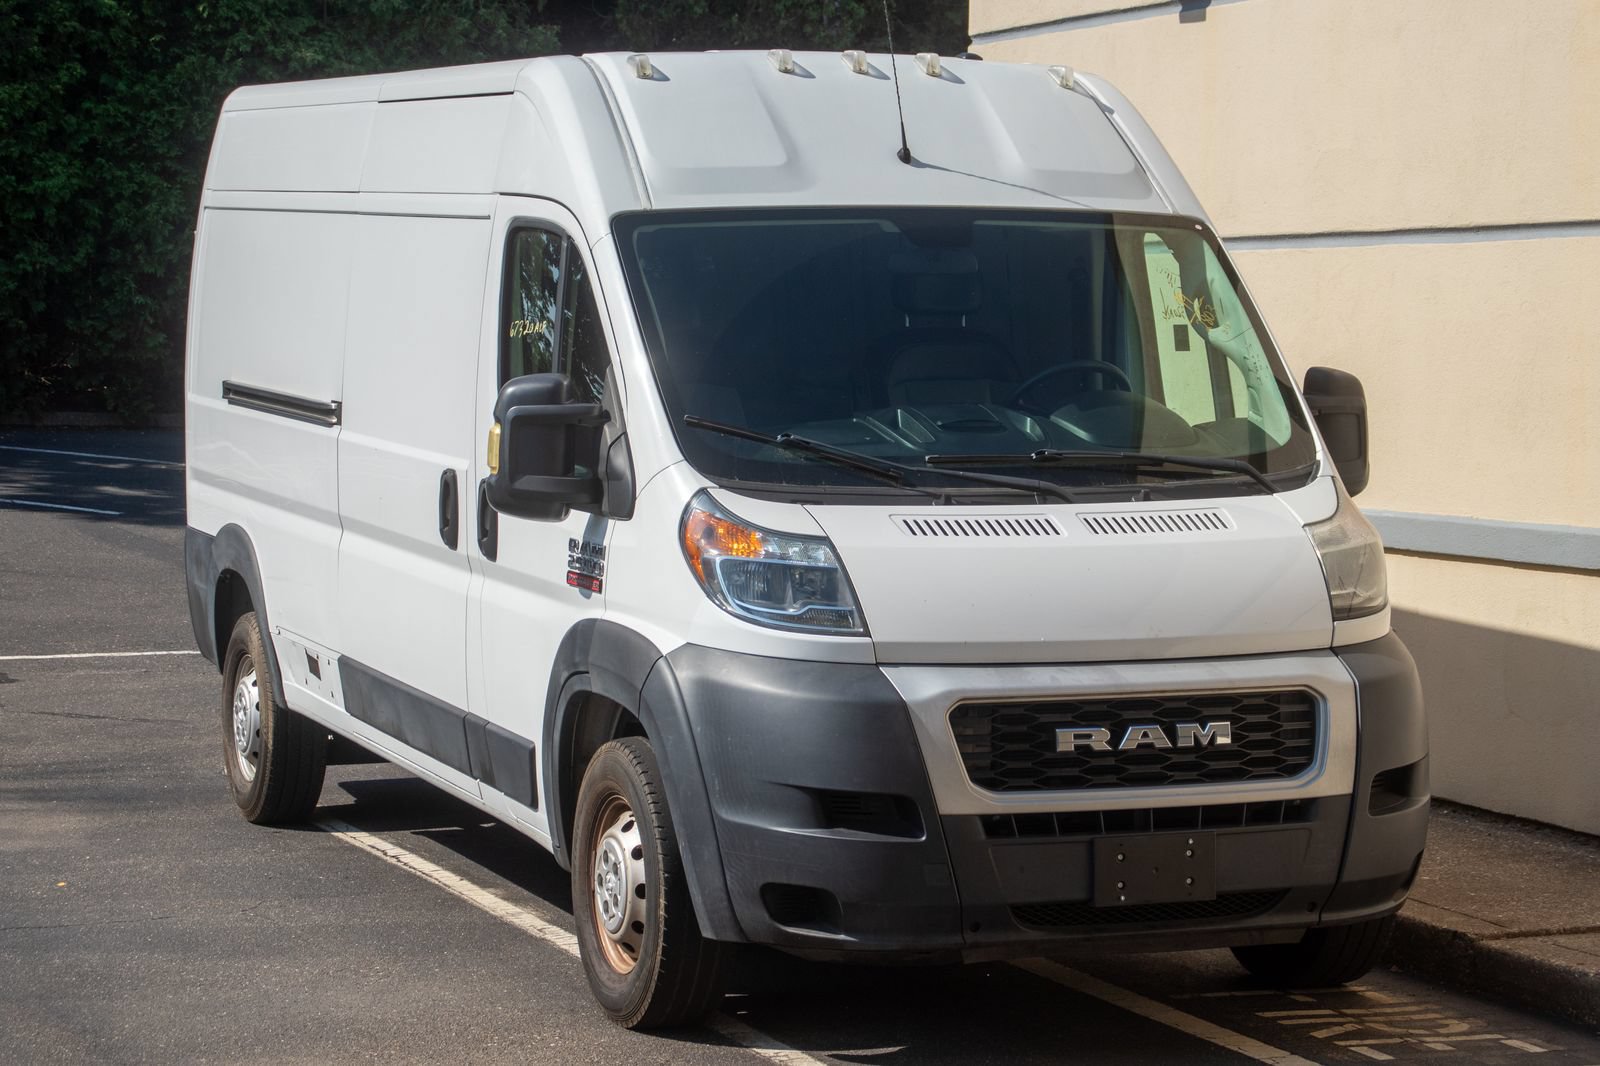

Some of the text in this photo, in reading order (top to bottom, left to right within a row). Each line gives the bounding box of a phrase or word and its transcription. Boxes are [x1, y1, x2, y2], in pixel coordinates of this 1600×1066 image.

[568, 537, 607, 561] RAM
[1055, 721, 1232, 752] RAM
[1170, 984, 1552, 1061] FIRE
